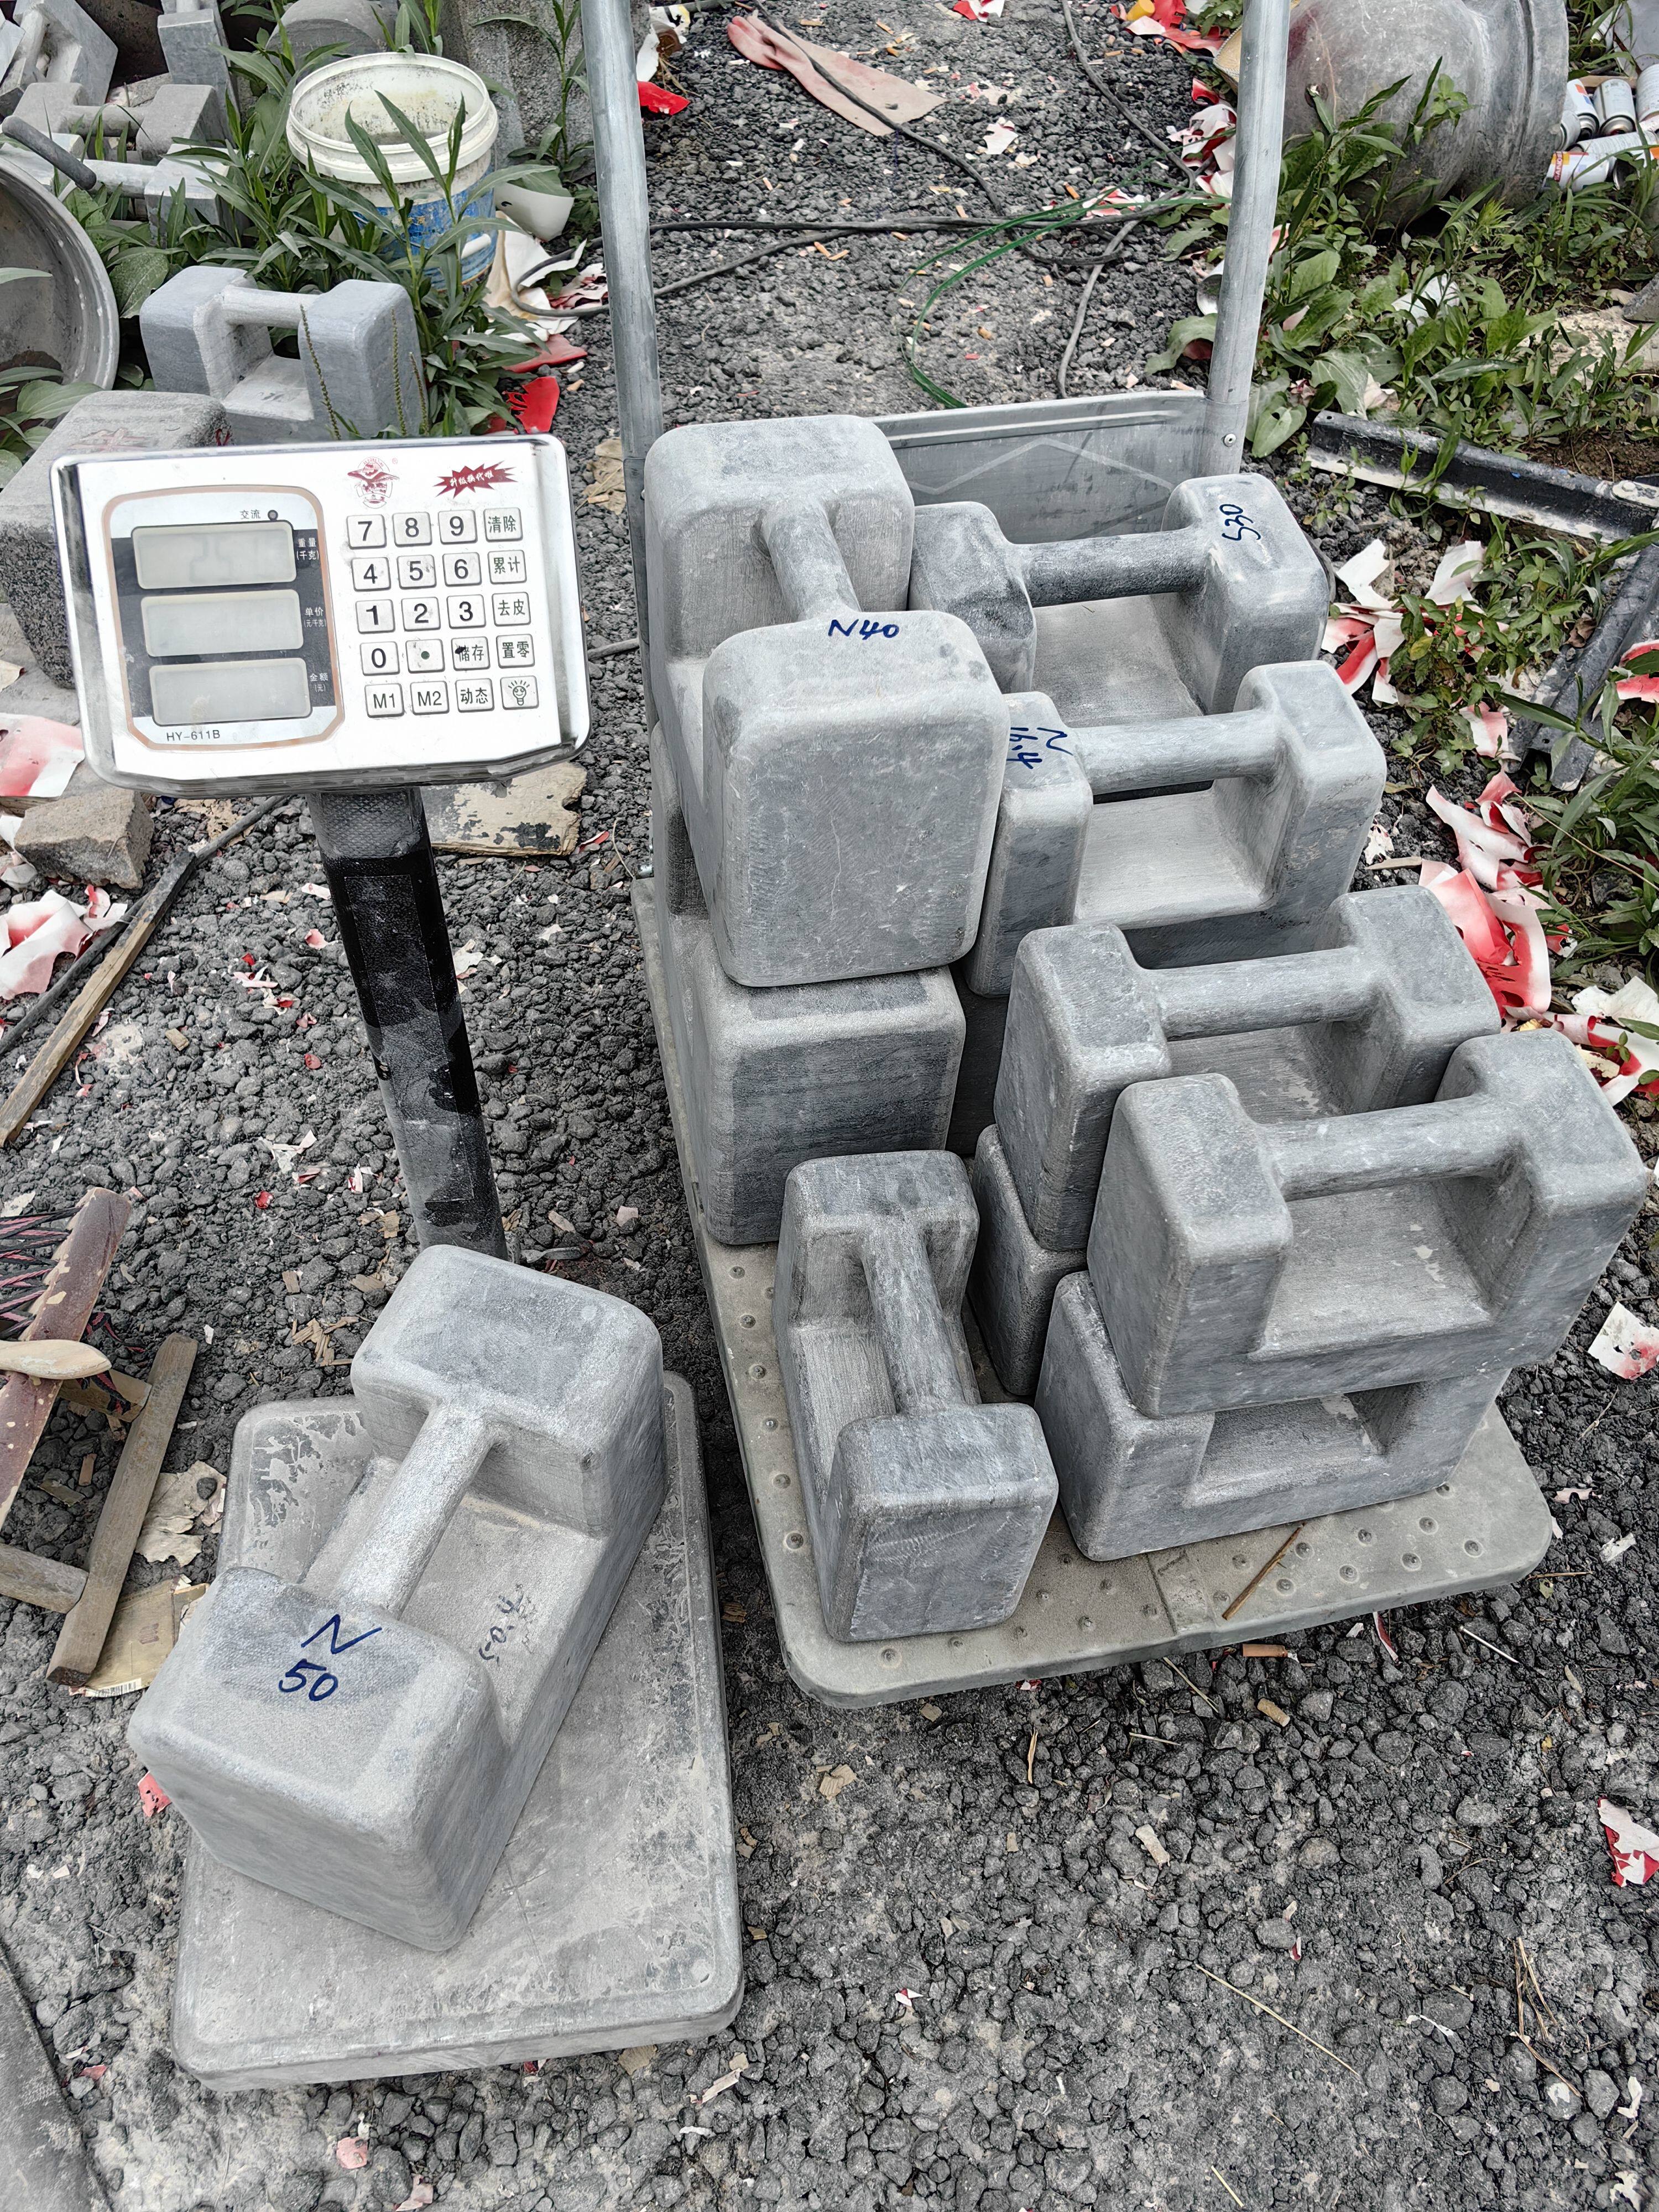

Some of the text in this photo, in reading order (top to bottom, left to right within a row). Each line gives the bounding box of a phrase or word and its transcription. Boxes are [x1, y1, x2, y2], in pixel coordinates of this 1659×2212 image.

[239, 509, 261, 519] 交流
[358, 521, 373, 541] 7
[405, 518, 420, 538] 8
[450, 516, 464, 536] 9
[488, 515, 517, 533] 清除
[298, 538, 316, 547] 重量
[296, 550, 319, 560] (千克)
[363, 564, 378, 585] 4
[409, 561, 423, 581] 5
[454, 559, 468, 579] 6
[493, 556, 520, 575] 累计
[305, 607, 324, 617] 单价
[366, 605, 379, 625] 1
[414, 603, 429, 624] 2
[459, 601, 473, 622] 3
[498, 599, 525, 617] 去皮
[828, 619, 900, 640] N40
[371, 648, 387, 669] 0
[457, 644, 484, 662] 储存
[502, 641, 529, 659] 置零
[310, 672, 328, 681] 金额
[315, 684, 326, 692] (元)
[461, 687, 488, 705] 动态
[373, 693, 396, 709] M1
[418, 691, 442, 707] M2
[166, 729, 220, 742] HY-611B
[301, 1614, 382, 1655] N
[279, 1658, 338, 1702] 50
